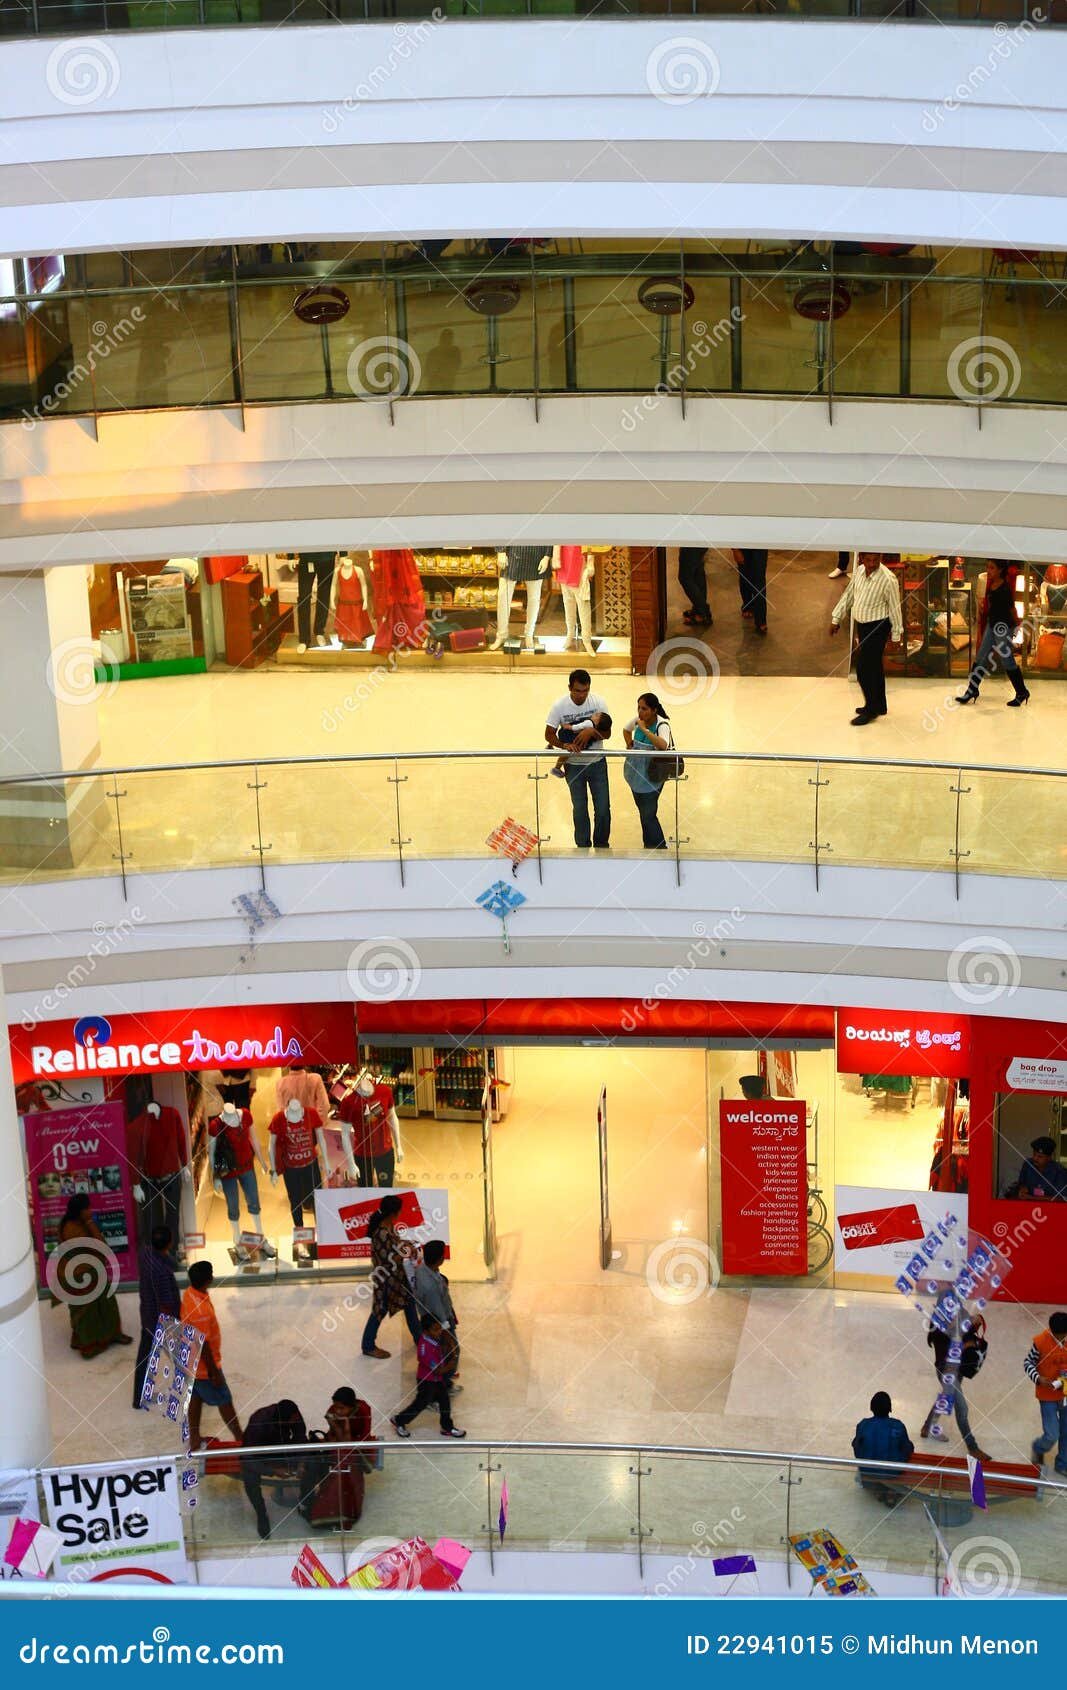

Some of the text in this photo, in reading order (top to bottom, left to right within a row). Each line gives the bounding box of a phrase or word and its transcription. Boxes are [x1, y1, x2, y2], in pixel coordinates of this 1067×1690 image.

[32, 1026, 303, 1075] Reliance trends
[1020, 1063, 1057, 1073] bag drop
[726, 1110, 799, 1123] welcome
[52, 1138, 99, 1157] new
[287, 1150, 312, 1161] YOU
[763, 1185, 797, 1193] sleepwear
[767, 1209, 799, 1217] jewellery
[763, 1217, 799, 1225] handbags
[762, 1225, 799, 1233] backpacks
[841, 1226, 858, 1239] 60
[857, 1227, 878, 1237] SALE
[762, 1233, 799, 1241] fragrances
[50, 1466, 172, 1511] Hyper
[56, 1508, 149, 1547] Sale
